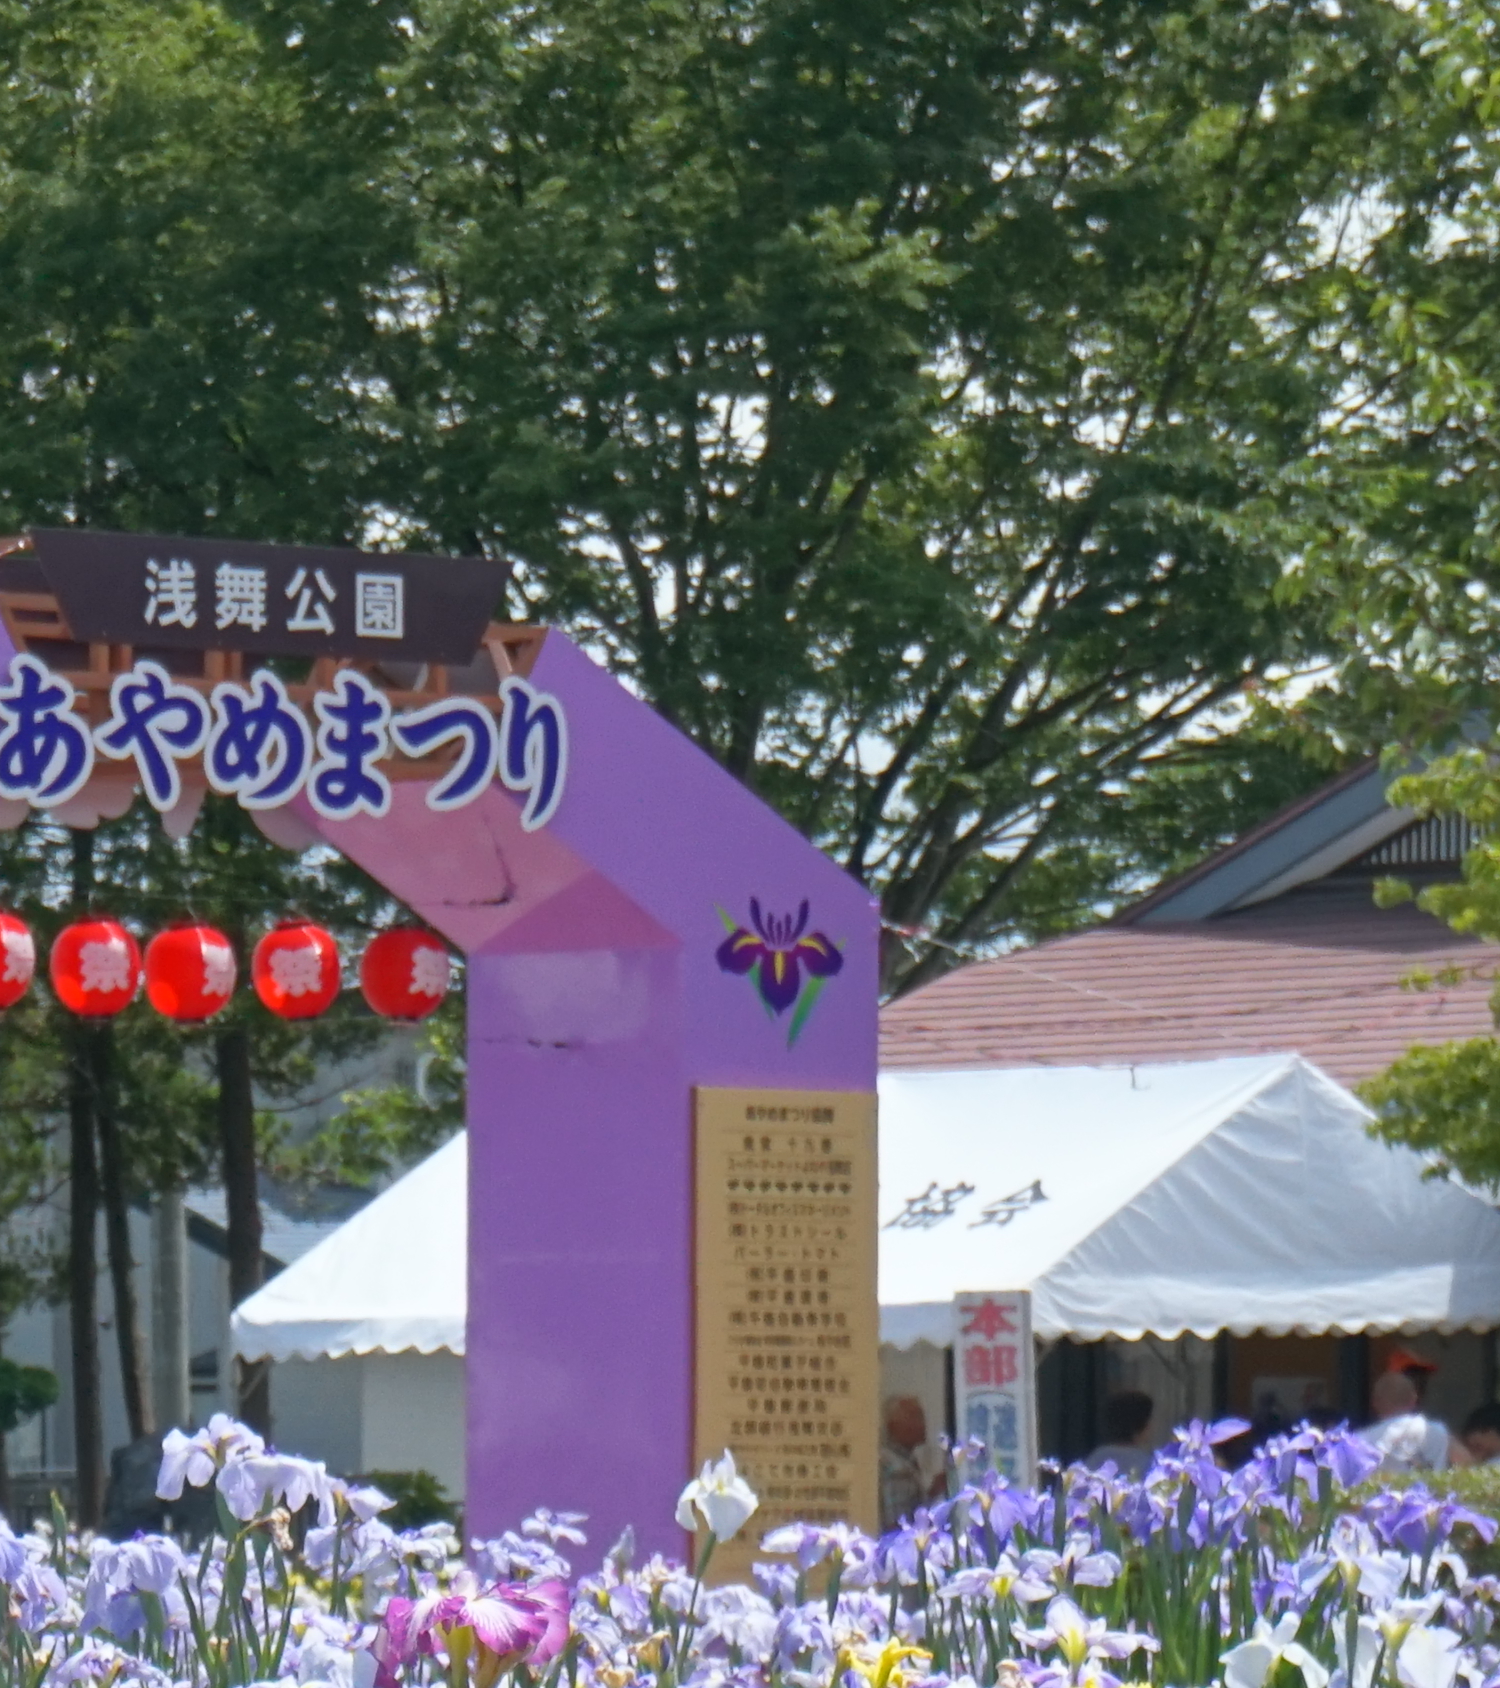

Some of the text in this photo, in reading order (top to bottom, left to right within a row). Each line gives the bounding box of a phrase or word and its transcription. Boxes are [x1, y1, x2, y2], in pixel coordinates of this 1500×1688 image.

[144, 559, 403, 638] 浅舞公園
[960, 1297, 1018, 1387] 本部
